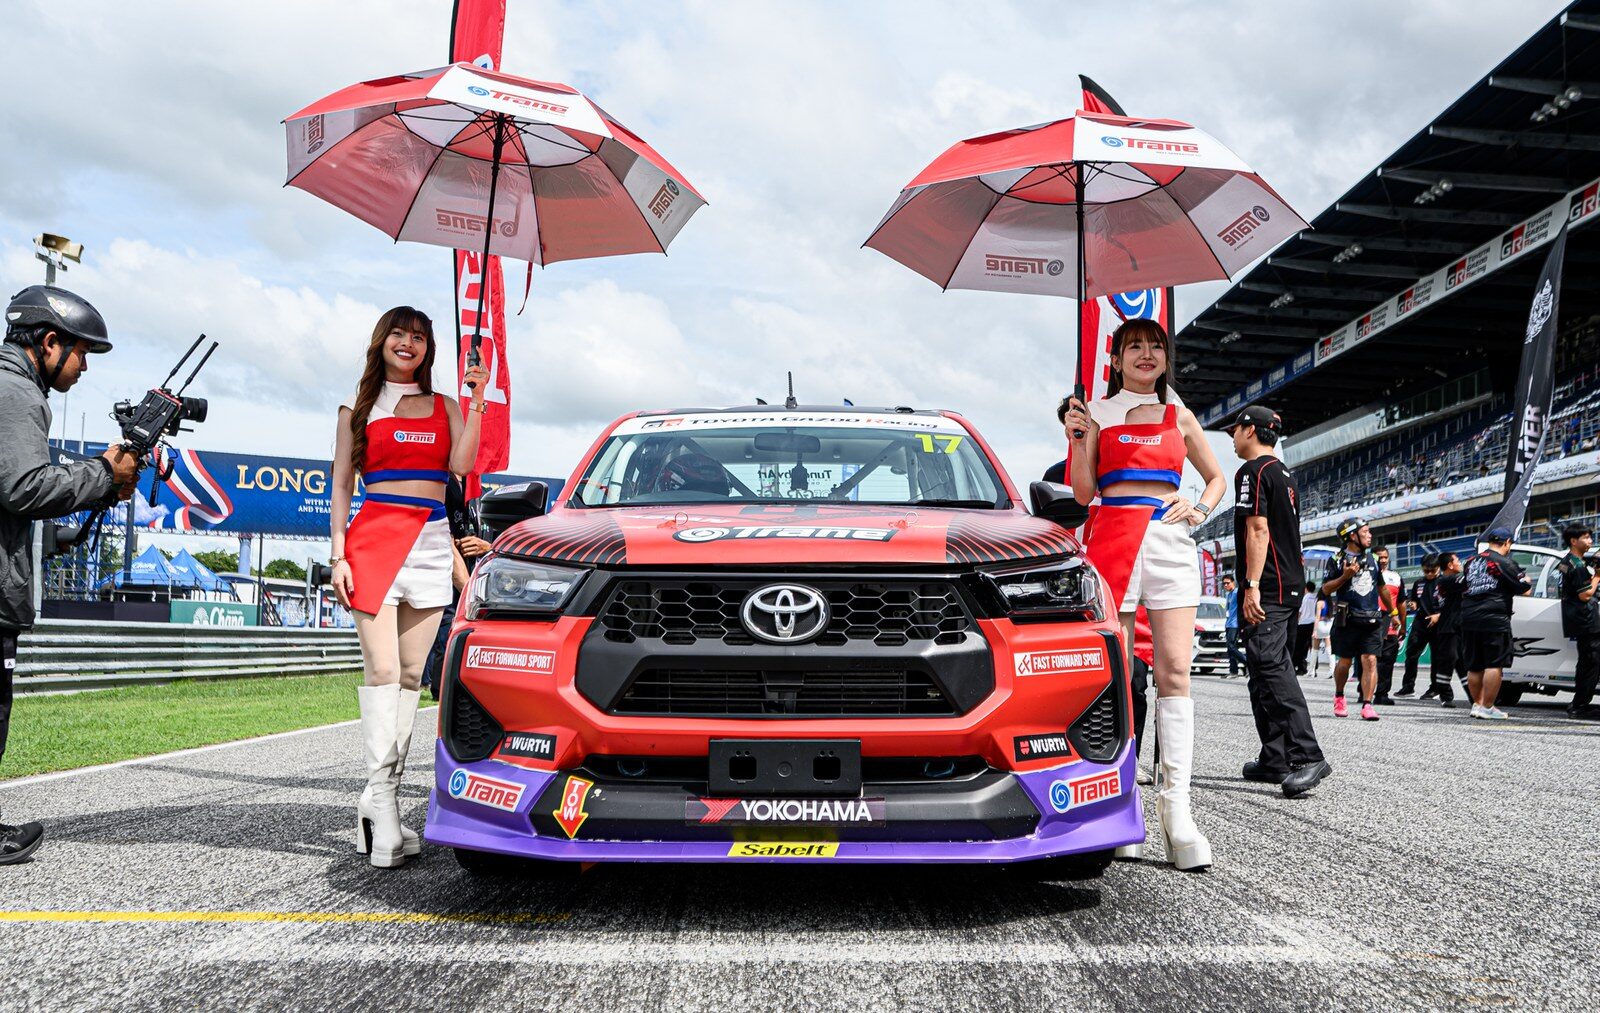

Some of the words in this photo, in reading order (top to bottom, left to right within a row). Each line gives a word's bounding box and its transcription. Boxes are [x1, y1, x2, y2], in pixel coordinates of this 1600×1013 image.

[490, 89, 569, 114] Trane
[1121, 137, 1199, 153] Trane
[1569, 194, 1597, 221] GR
[1502, 236, 1523, 260] GR
[689, 417, 775, 425] TOYOTA
[865, 419, 938, 429] Racing
[404, 432, 434, 442] Trane
[915, 433, 964, 454] 17
[235, 464, 326, 494] LONG
[298, 505, 314, 513] AND
[304, 498, 324, 506] WITH
[732, 526, 892, 541] Trane
[480, 651, 496, 665] FAST
[495, 652, 528, 667] FORWARD
[528, 654, 552, 669] SPORT
[1032, 655, 1050, 670] FAST
[1051, 654, 1082, 669] FORWARD
[1083, 652, 1101, 666] SPORT
[465, 774, 522, 809] Trane
[1069, 770, 1119, 804] Trane
[563, 780, 586, 821] TOW
[741, 800, 873, 822] YOKOHAMA
[740, 843, 828, 857] Sabelt
